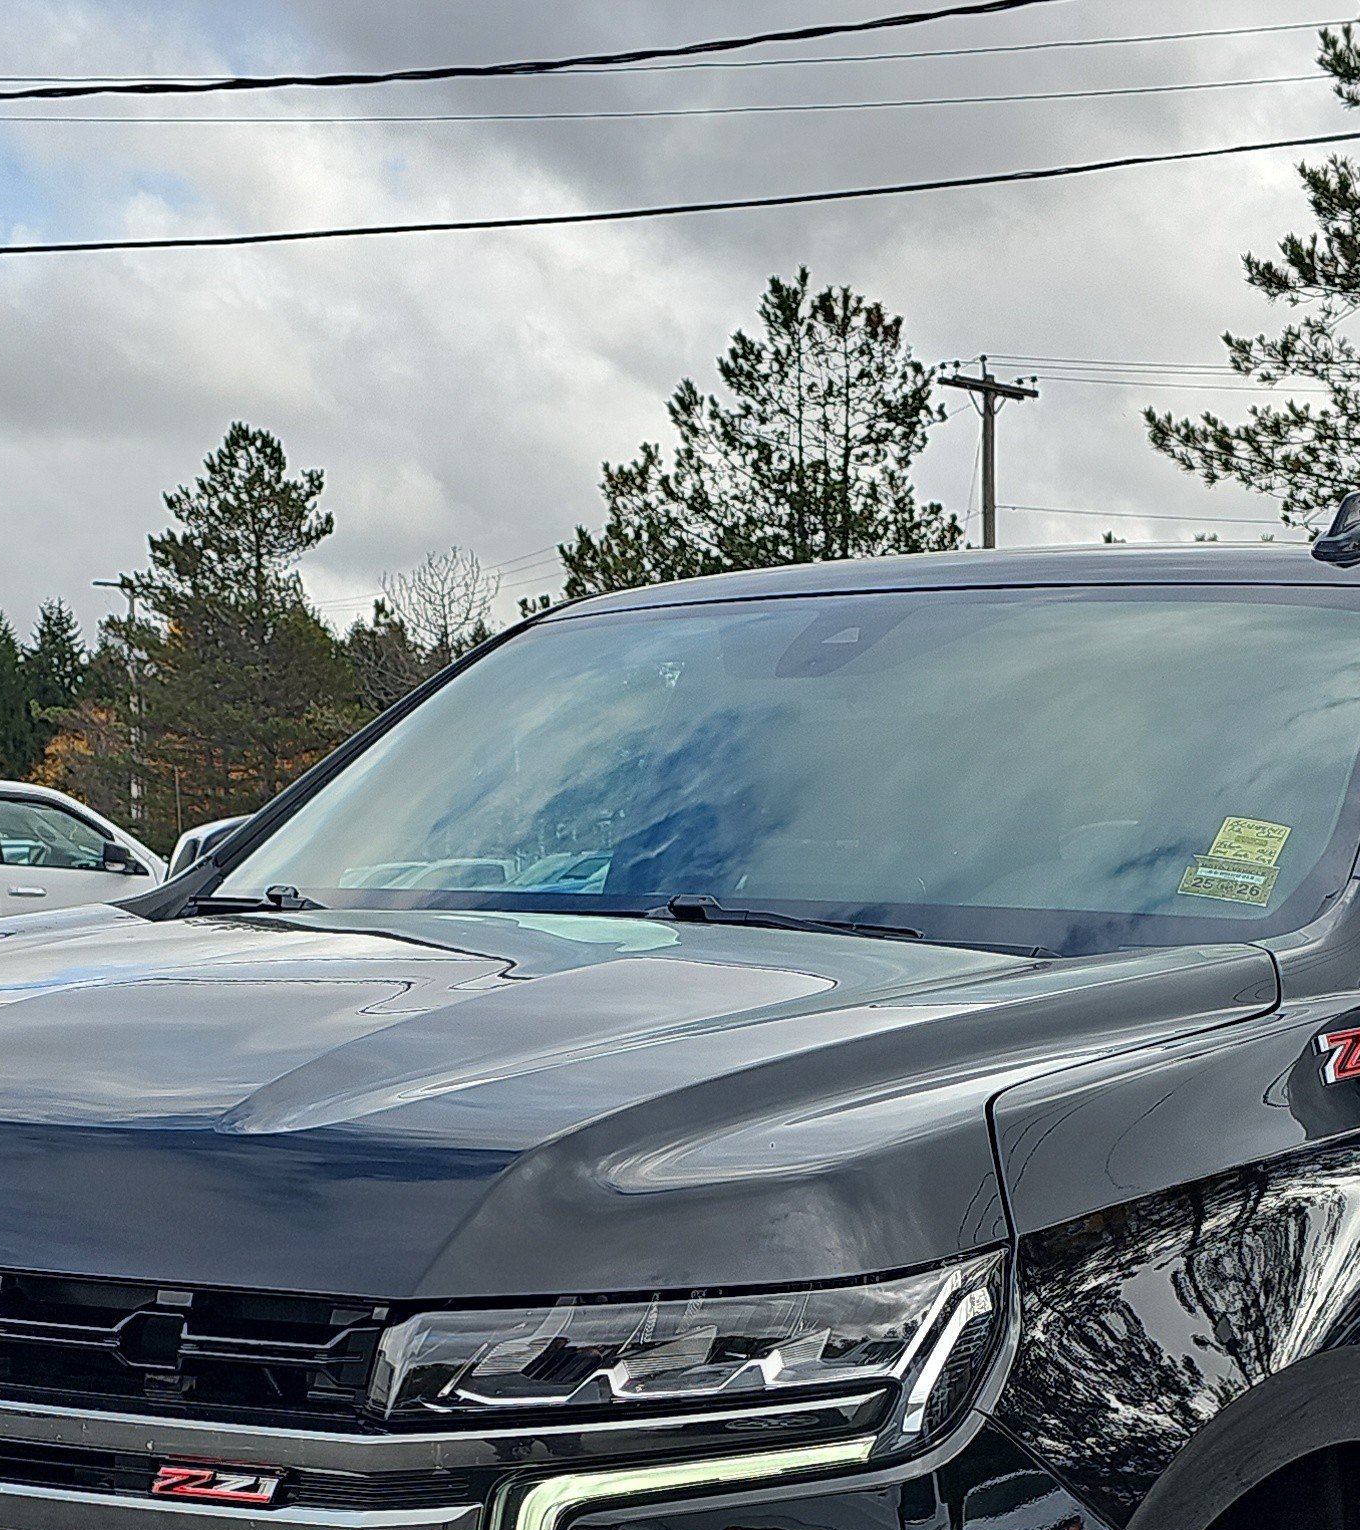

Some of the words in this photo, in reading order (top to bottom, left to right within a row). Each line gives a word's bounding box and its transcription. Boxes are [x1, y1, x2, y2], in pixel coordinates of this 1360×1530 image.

[1191, 876, 1215, 890] 25
[1236, 882, 1261, 897] 26
[151, 1466, 279, 1504] Z71
